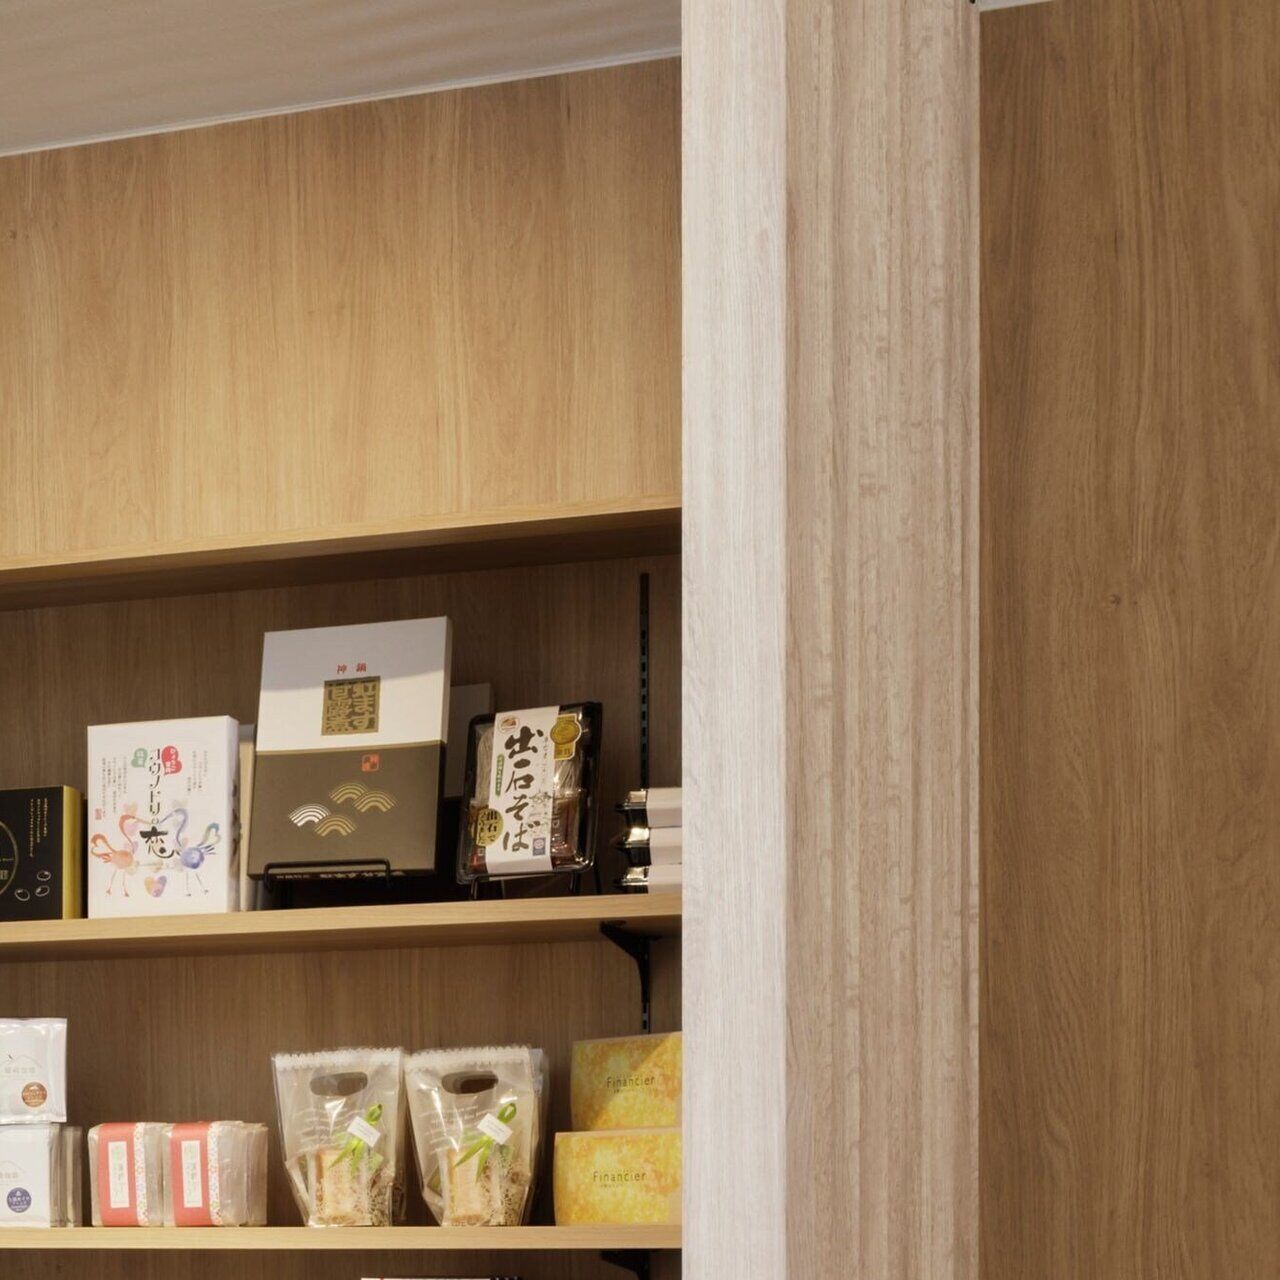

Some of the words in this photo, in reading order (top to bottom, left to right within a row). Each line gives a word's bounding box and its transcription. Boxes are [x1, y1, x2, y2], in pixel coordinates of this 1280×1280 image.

[502, 725, 544, 853] 出石そば
[606, 1075, 655, 1089] Financier
[593, 1170, 647, 1182] Financier
